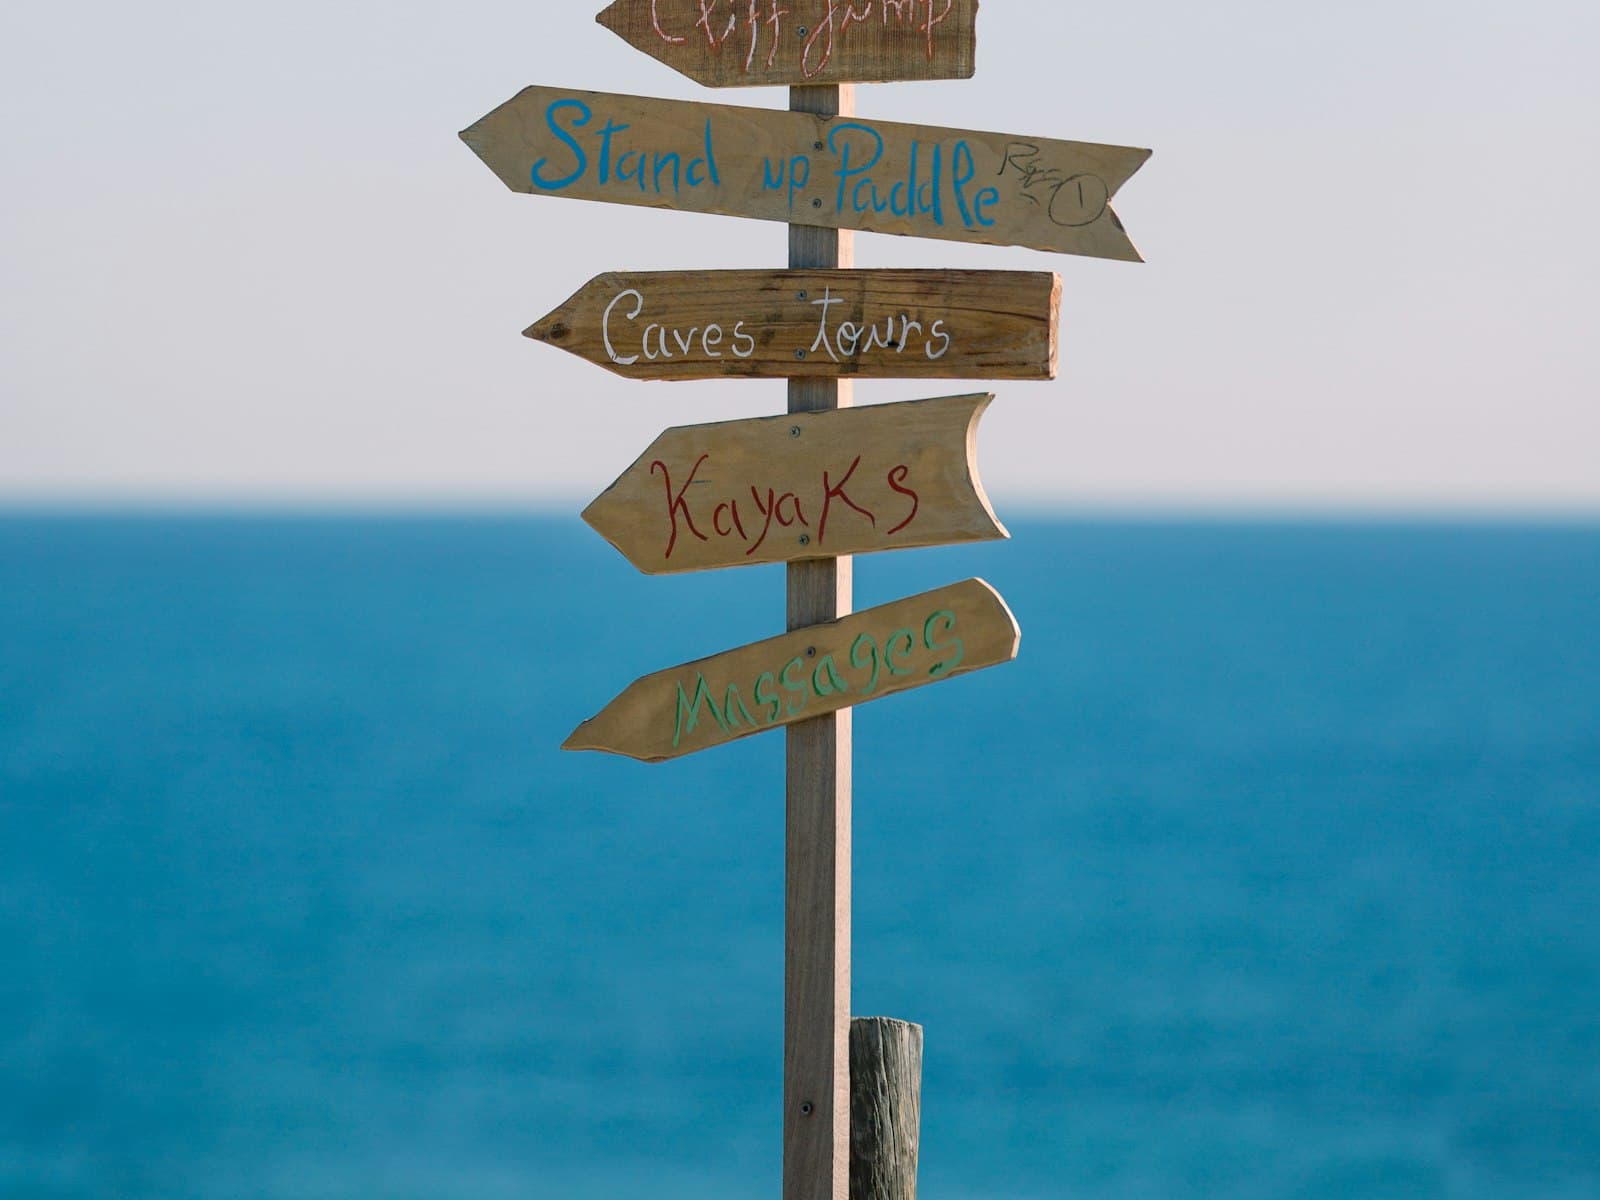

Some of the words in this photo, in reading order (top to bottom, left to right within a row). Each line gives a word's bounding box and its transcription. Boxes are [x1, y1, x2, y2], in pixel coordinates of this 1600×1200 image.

[531, 99, 720, 193] Stand
[763, 153, 810, 210] up
[827, 123, 1000, 228] Paddle
[602, 288, 756, 366] Caves
[672, 609, 966, 748] Massages
